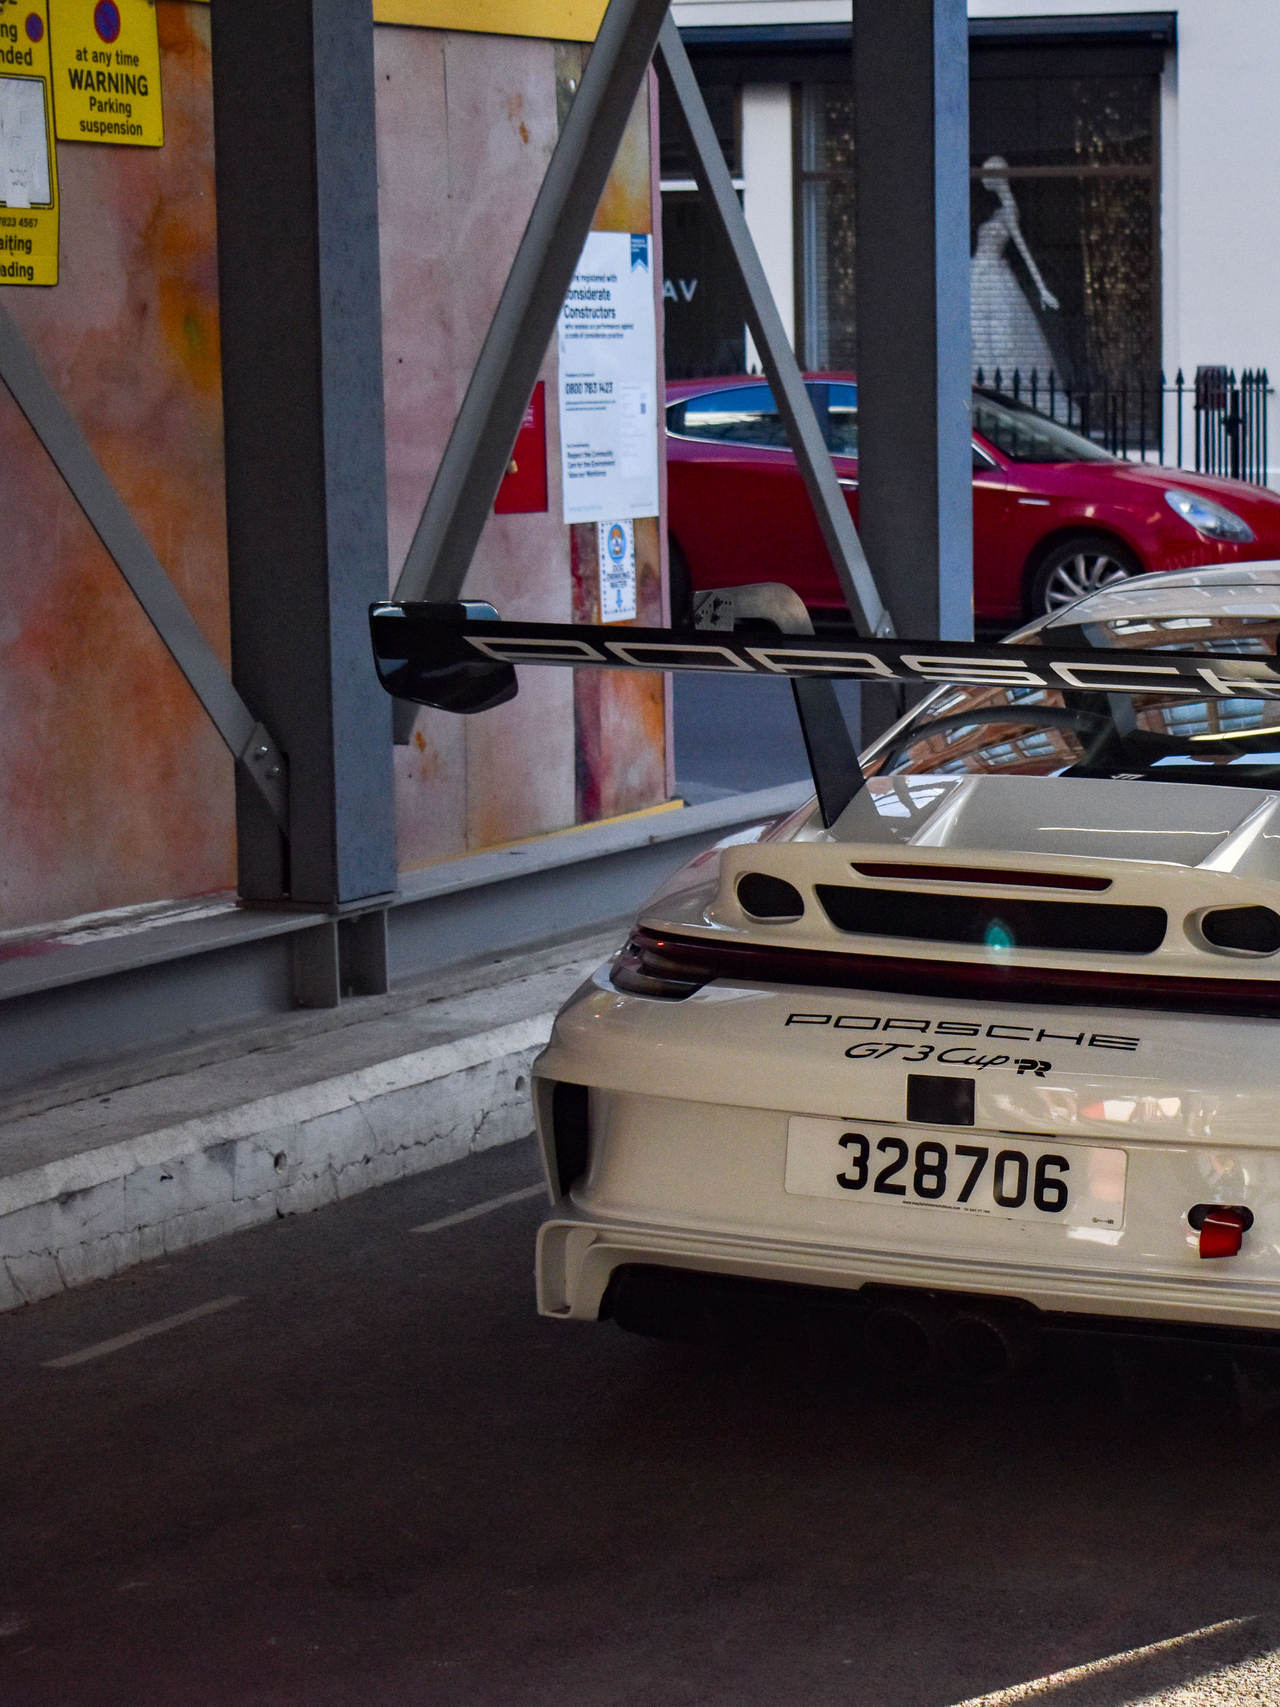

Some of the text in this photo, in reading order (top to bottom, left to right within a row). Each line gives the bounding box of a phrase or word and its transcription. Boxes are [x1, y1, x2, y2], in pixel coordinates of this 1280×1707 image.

[76, 48, 139, 67] at any time
[68, 68, 149, 96] WARNING
[90, 96, 132, 117] Parking
[80, 118, 143, 136] suspension
[18, 217, 39, 228] 4567
[607, 273, 618, 282] with
[563, 305, 616, 319] Constructors
[565, 382, 582, 395] 0800
[784, 1013, 1141, 1052] PORSCHE
[936, 1047, 1011, 1071] Cup
[836, 1132, 1071, 1213] 328706
